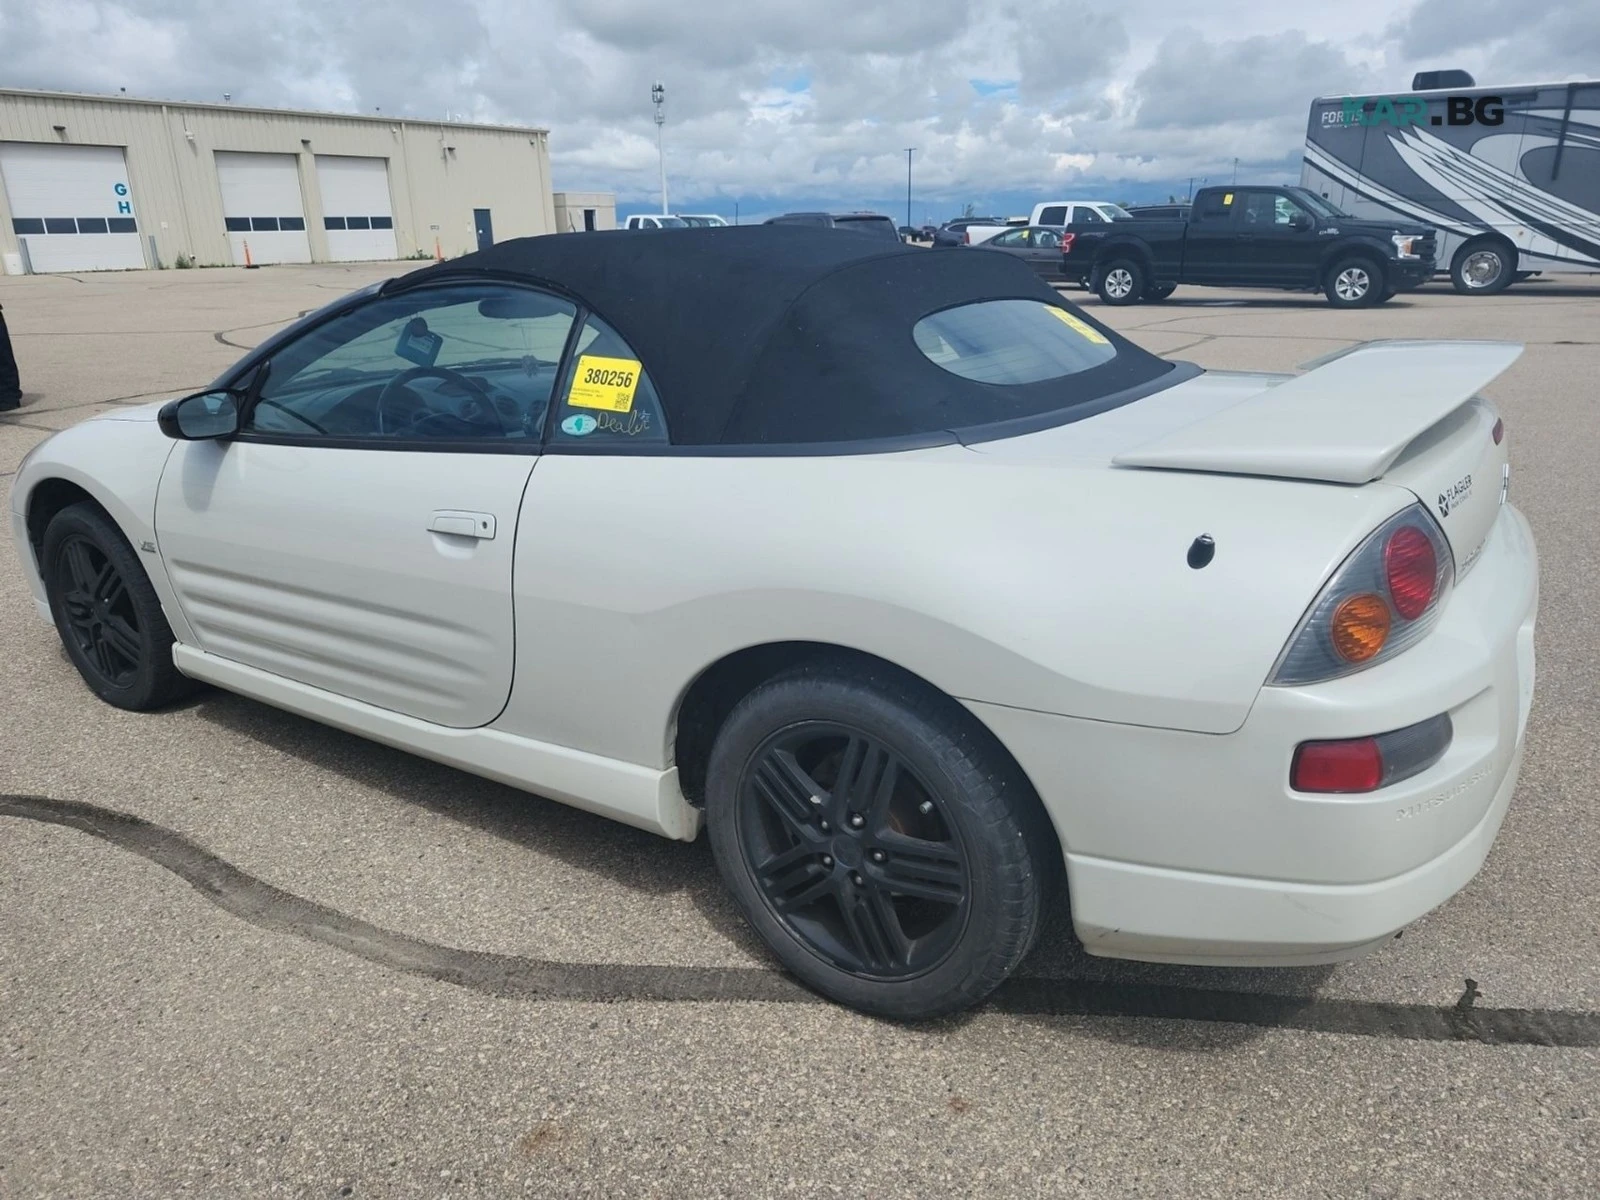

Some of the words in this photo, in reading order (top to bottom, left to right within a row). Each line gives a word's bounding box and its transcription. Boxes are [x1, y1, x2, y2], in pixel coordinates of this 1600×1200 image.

[114, 183, 128, 196] G
[118, 201, 131, 214] H
[584, 368, 634, 388] 380256
[1446, 474, 1472, 501] FLAGLER
